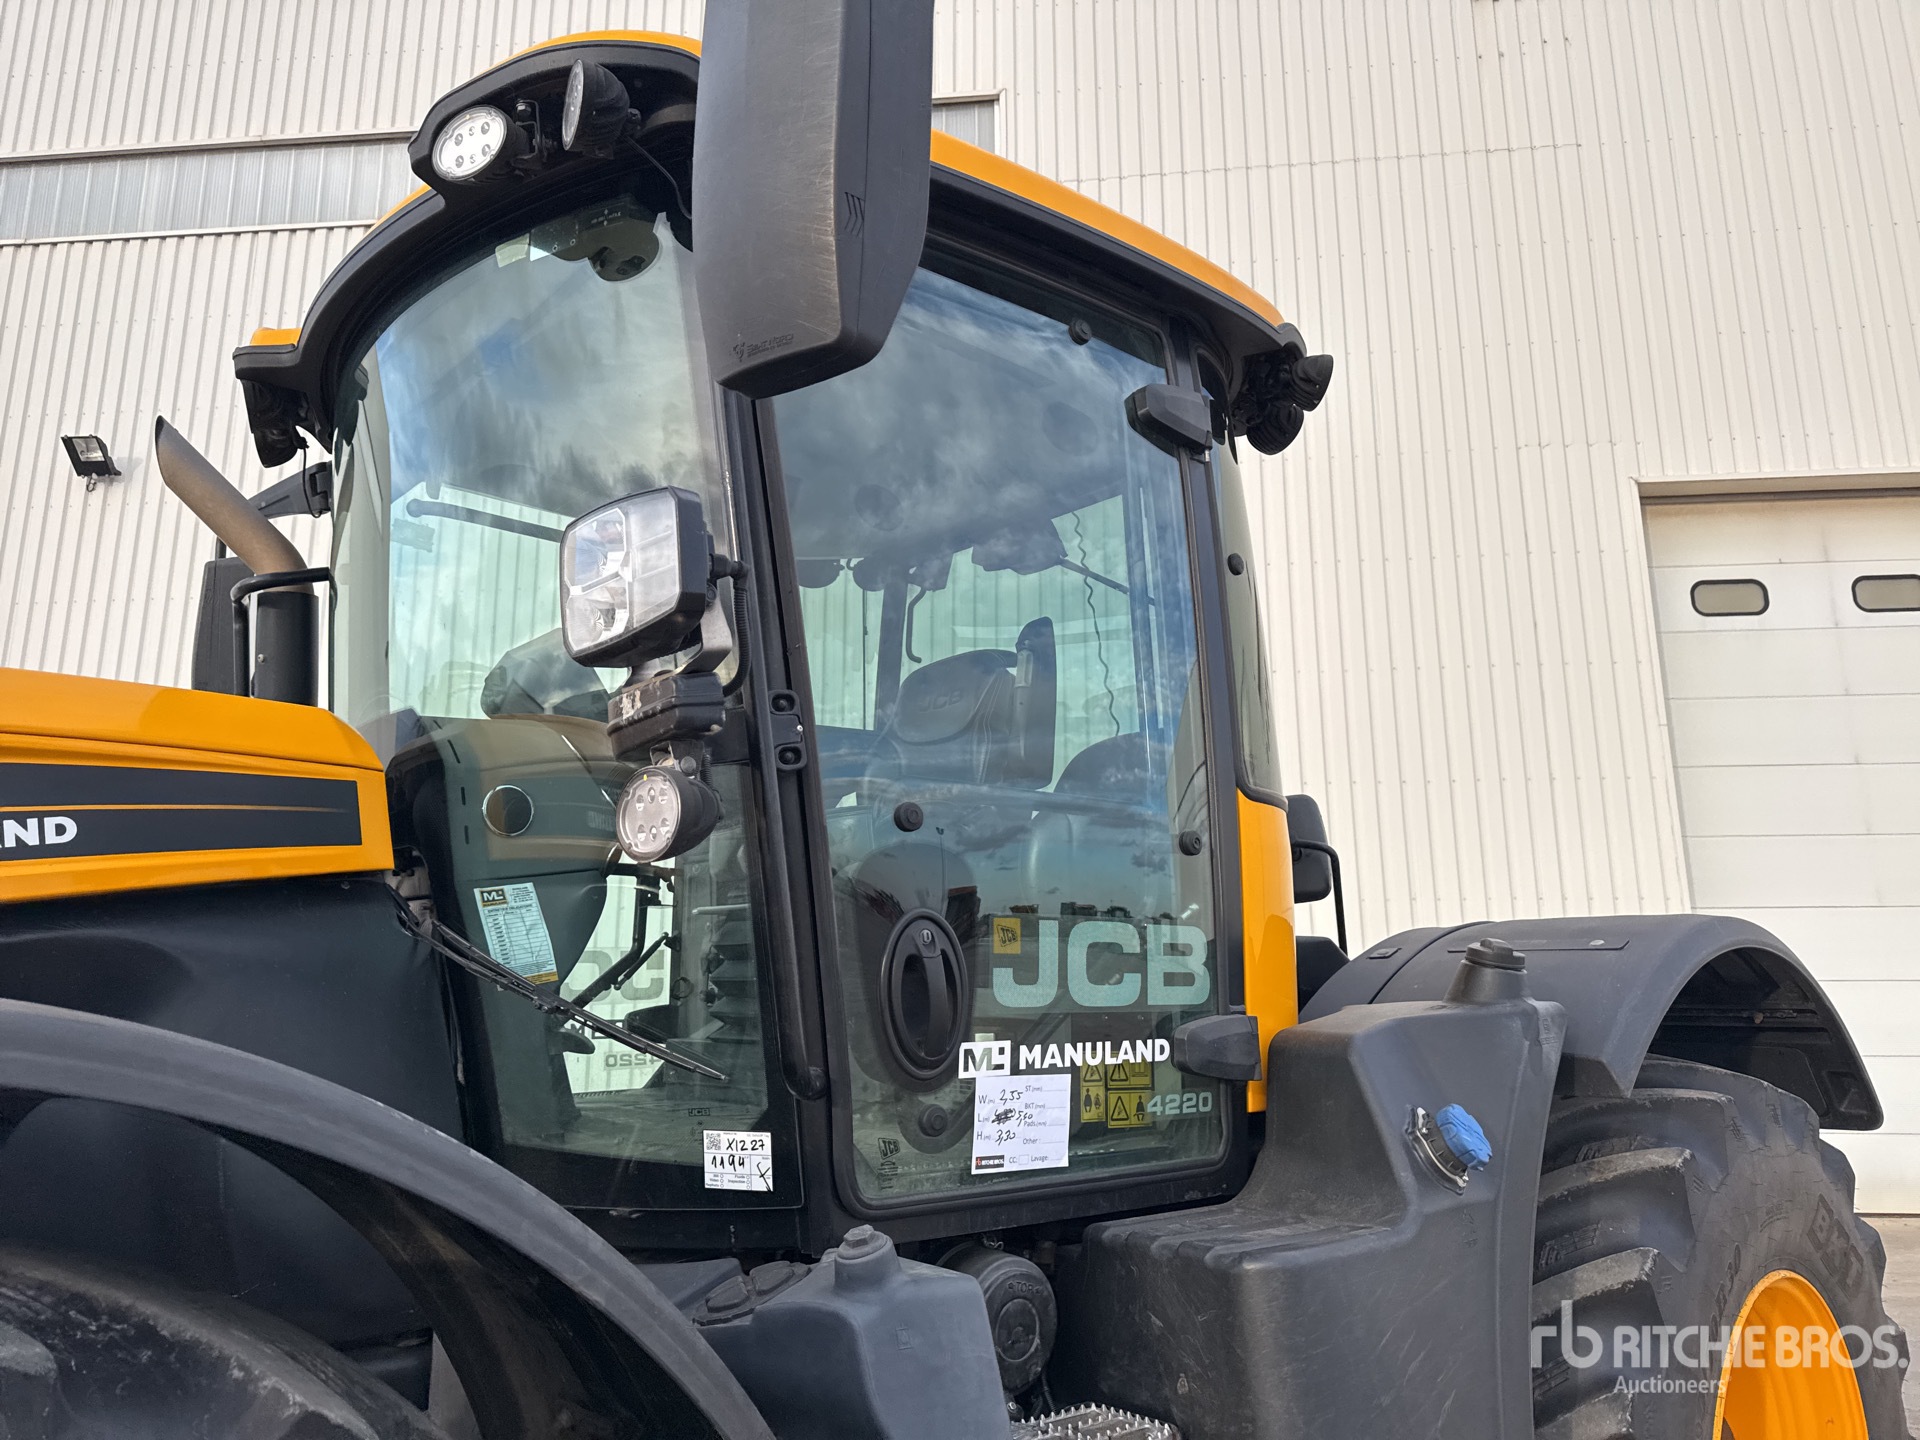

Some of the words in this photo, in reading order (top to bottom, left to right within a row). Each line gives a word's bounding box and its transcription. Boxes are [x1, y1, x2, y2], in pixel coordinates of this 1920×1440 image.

[0, 816, 78, 848] ND
[1001, 927, 1017, 943] JCB
[992, 919, 1211, 1008] JCB
[1019, 1038, 1171, 1070] MANULAND
[1146, 1091, 1213, 1115] 4220
